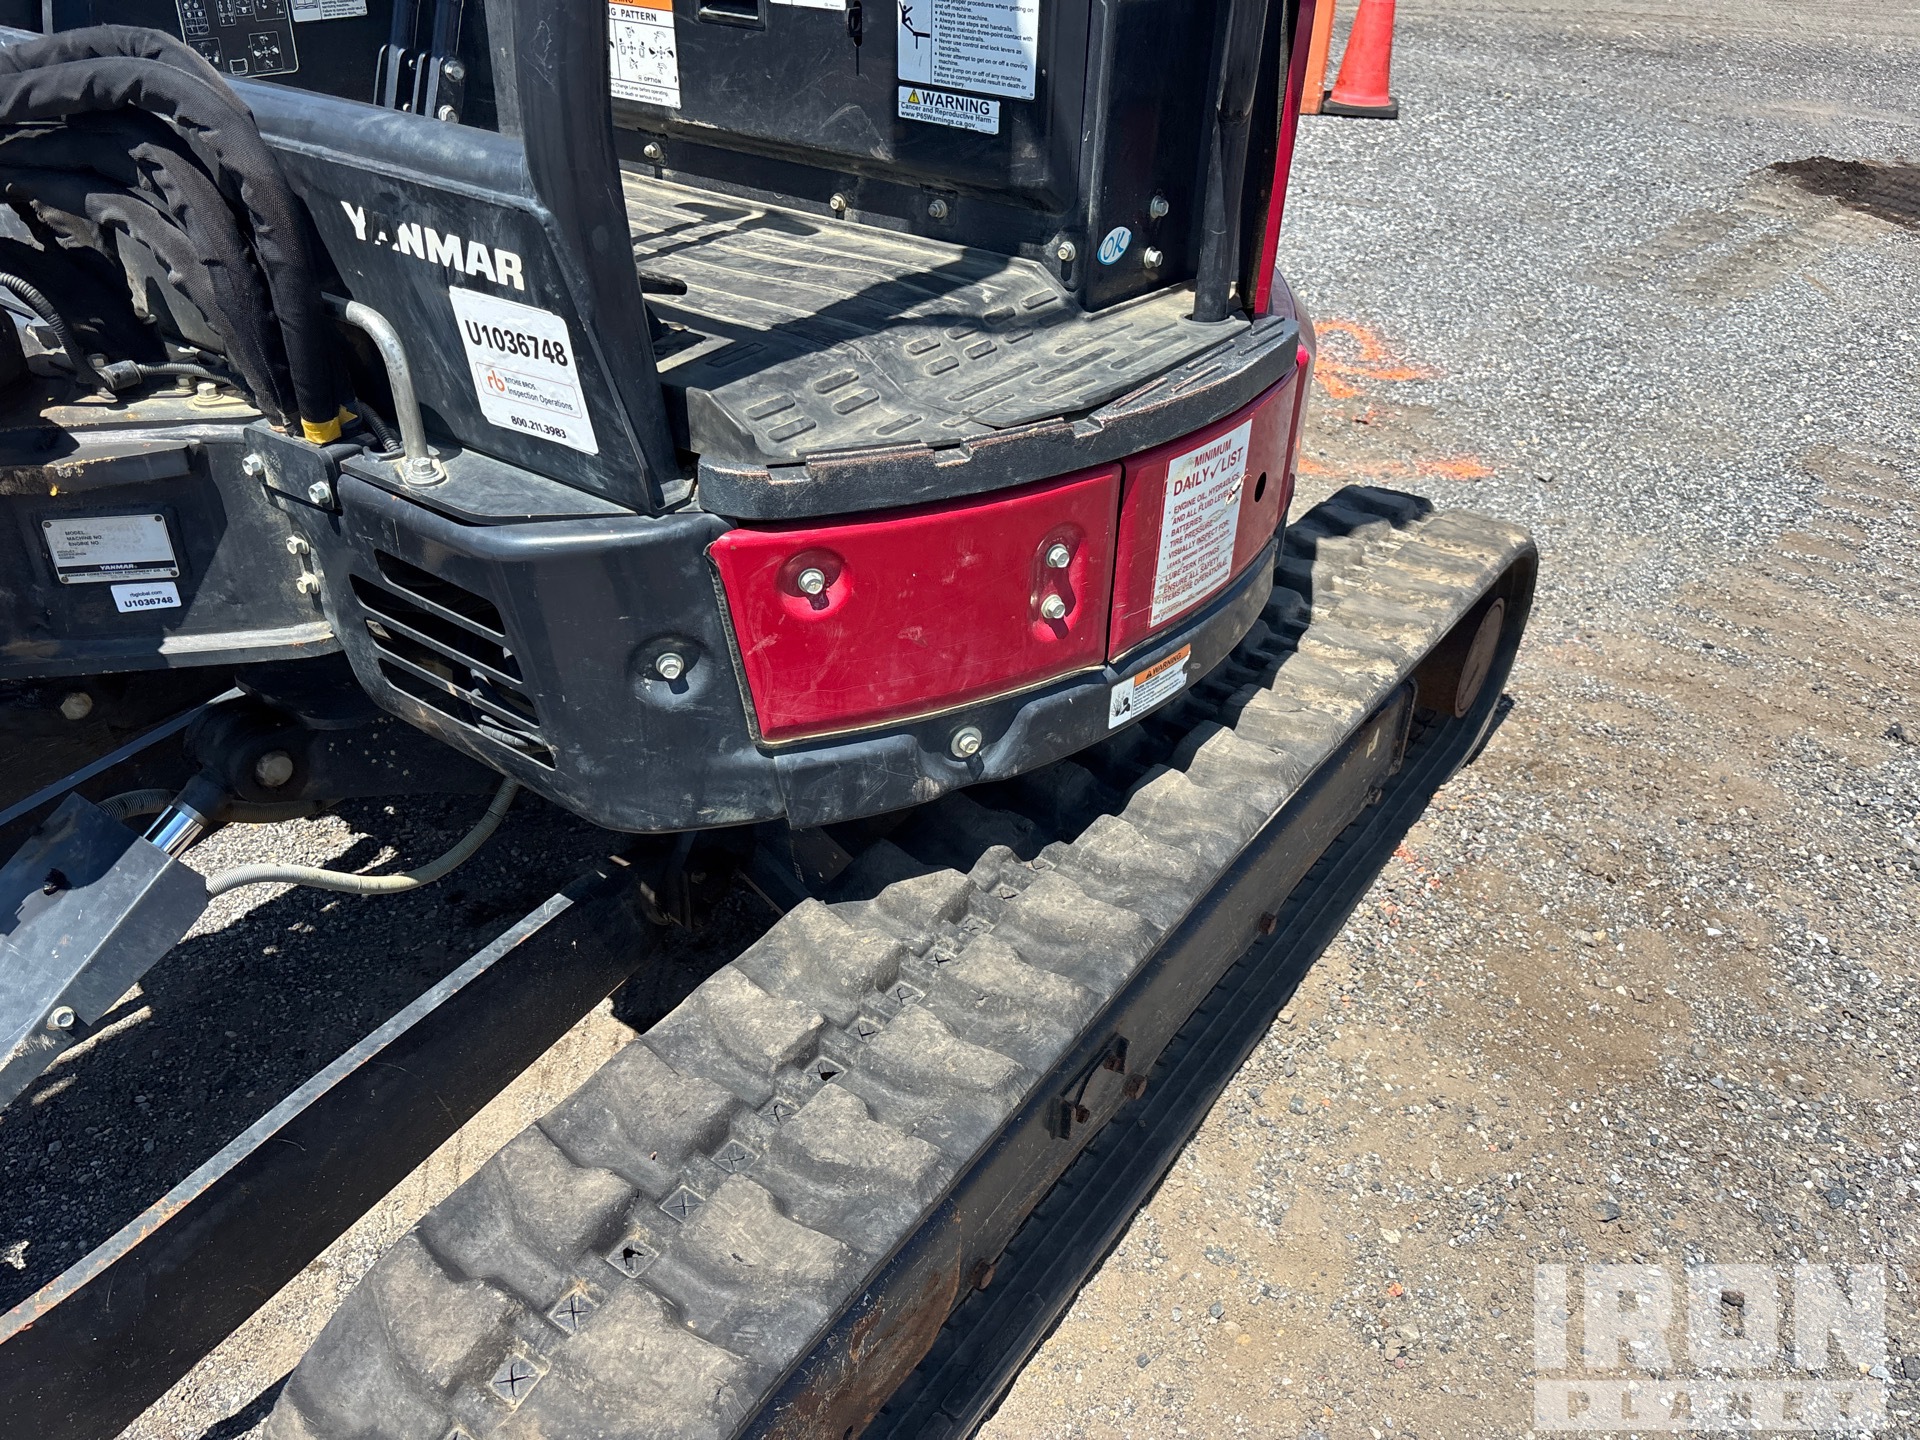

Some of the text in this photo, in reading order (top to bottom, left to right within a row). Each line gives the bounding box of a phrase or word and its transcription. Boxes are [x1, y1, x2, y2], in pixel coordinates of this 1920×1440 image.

[939, 10, 956, 18] Always
[967, 1, 995, 9] procedures
[620, 9, 657, 22] PATTERN
[939, 17, 956, 25] Always
[990, 24, 1013, 32] handrails.
[939, 24, 956, 32] Always
[977, 28, 1003, 38] three-point
[962, 34, 985, 42] handrails.
[939, 37, 952, 45] Never
[962, 41, 979, 49] control
[939, 45, 961, 53] handrails.
[938, 51, 952, 59] Never
[953, 54, 970, 62] attempt
[1010, 62, 1028, 71] moving
[644, 76, 662, 84] OPTION
[934, 71, 949, 79] Failure
[955, 74, 973, 83] comply
[1006, 81, 1021, 89] death
[934, 77, 951, 85] serious
[952, 67, 964, 75] jump
[1001, 74, 1022, 82] machine.
[901, 102, 921, 112] Cancer
[922, 106, 933, 114] and
[935, 108, 974, 121] Reproductive
[975, 115, 992, 124] Harm
[922, 91, 990, 115] WARNING
[1103, 231, 1126, 260] OK
[465, 320, 568, 367] U1036748
[487, 370, 506, 392] rb
[507, 386, 573, 411] Inspection Operations
[510, 415, 567, 439] 800.211.3983
[1194, 438, 1232, 468] MINIMUM
[1173, 446, 1244, 497] DAILY LIST
[1172, 513, 1186, 526] AND
[1186, 509, 1198, 519] ALL
[1198, 498, 1214, 513] FLUID
[1174, 496, 1196, 514] ENGINE
[1170, 515, 1203, 538] BATTERIES
[1170, 519, 1213, 548] TIRE PRESSURE
[1168, 540, 1196, 559] VISUALLY
[1196, 526, 1218, 546] INSPECT
[1165, 545, 1220, 582] LUBE ZERK FITTINGS
[1164, 556, 1219, 594] ENSURE ALL SAFETY
[124, 596, 174, 608] U1036748
[129, 590, 163, 598] rbglobal.com
[1161, 590, 1180, 604] ITEMS
[1152, 653, 1182, 674] WARNING
